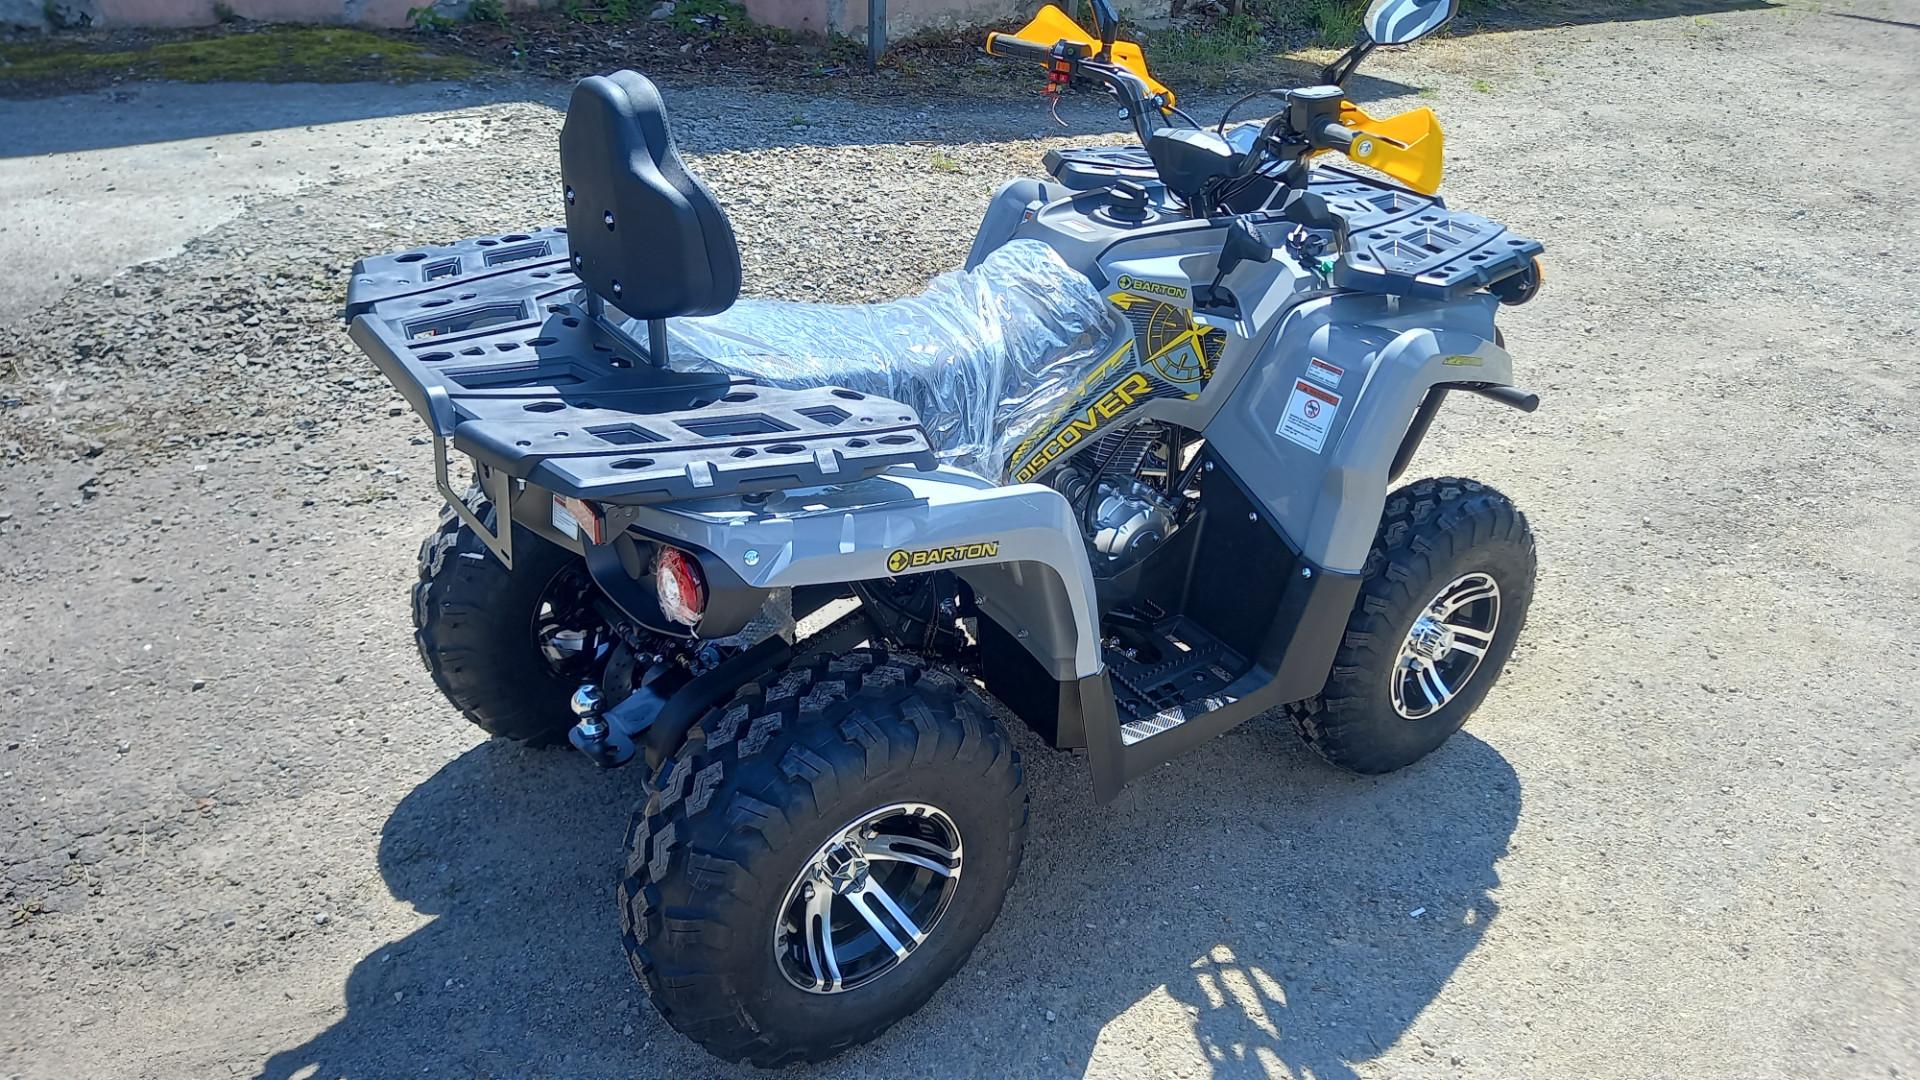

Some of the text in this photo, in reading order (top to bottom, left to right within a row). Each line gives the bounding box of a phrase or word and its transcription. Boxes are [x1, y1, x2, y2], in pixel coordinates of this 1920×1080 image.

[1133, 279, 1187, 298] BARTON
[1016, 373, 1153, 482] DISCOVER
[911, 543, 998, 567] BARTON
